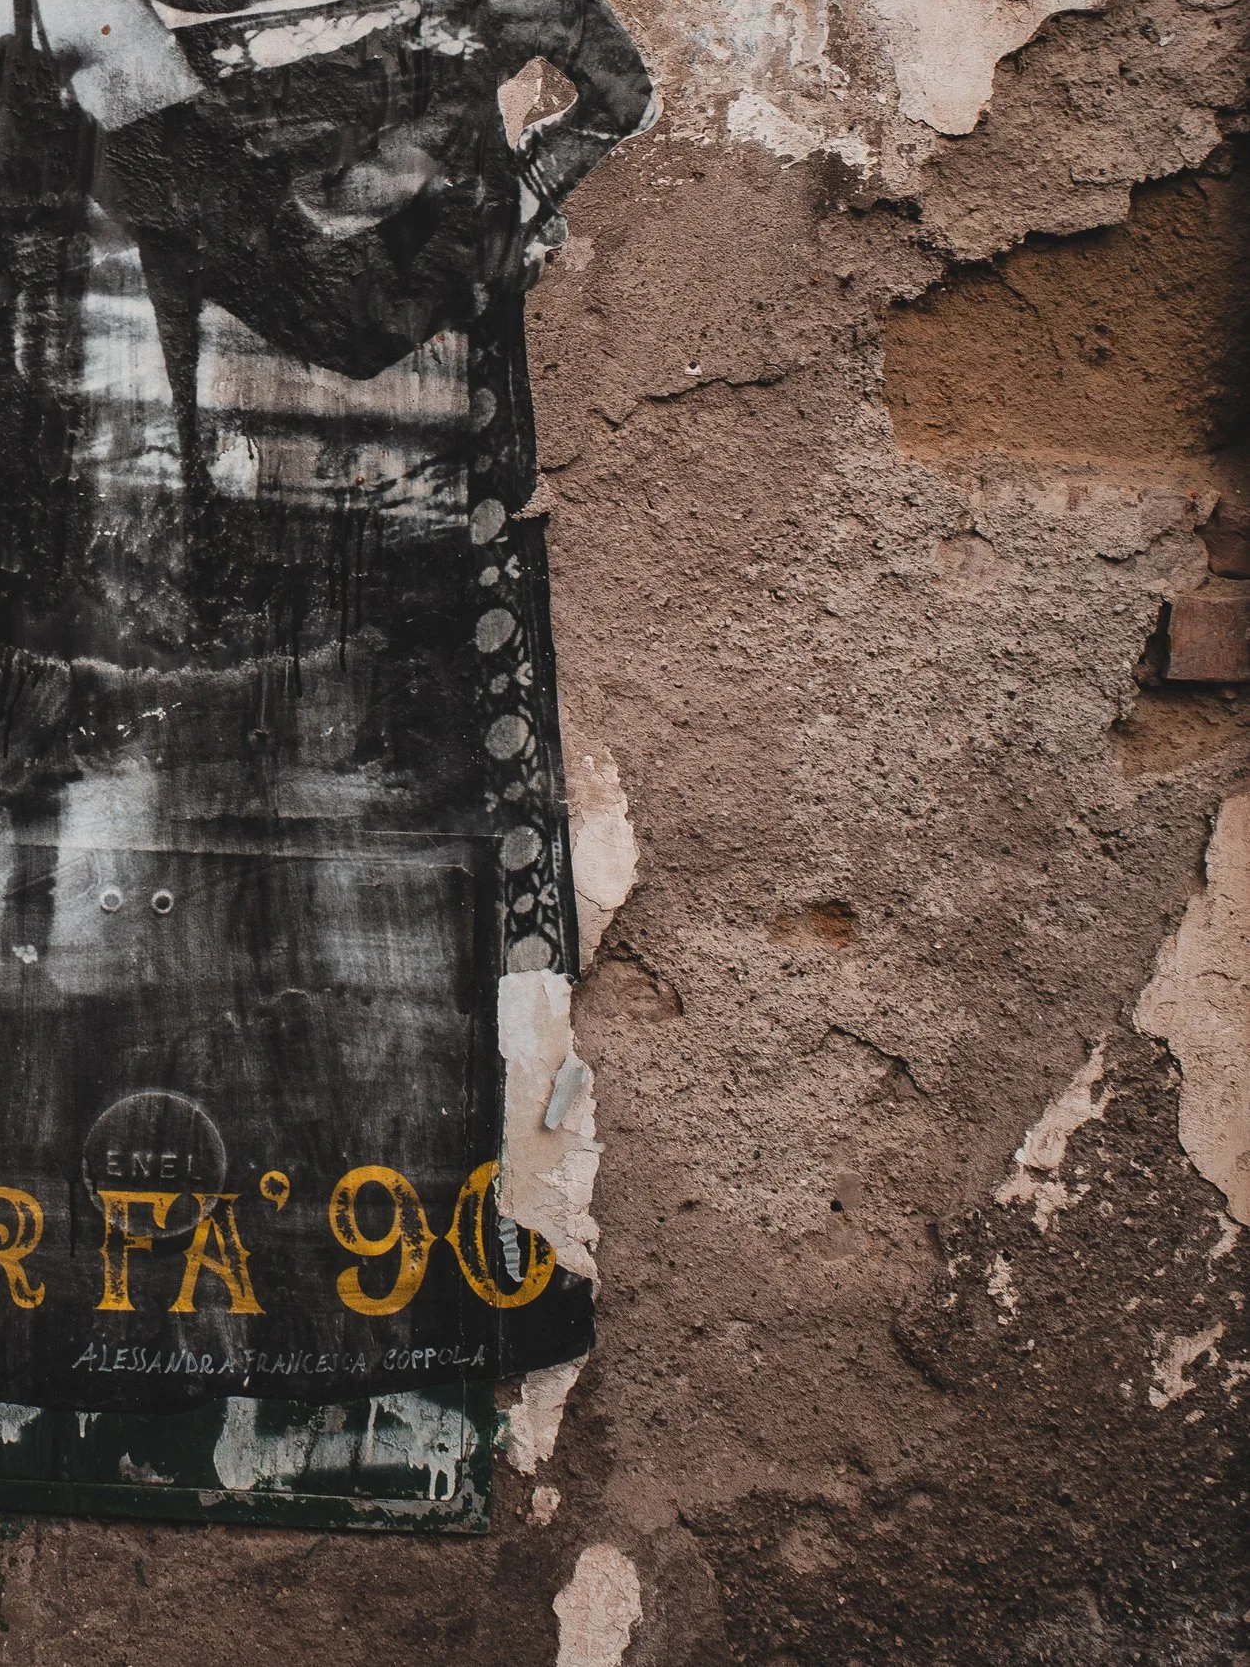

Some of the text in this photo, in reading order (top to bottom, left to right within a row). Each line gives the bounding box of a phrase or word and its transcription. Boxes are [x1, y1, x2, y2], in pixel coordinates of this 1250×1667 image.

[106, 1150, 202, 1180] ENEL
[71, 1341, 236, 1375] ALESSANDRA
[383, 1344, 486, 1370] COPPOLA
